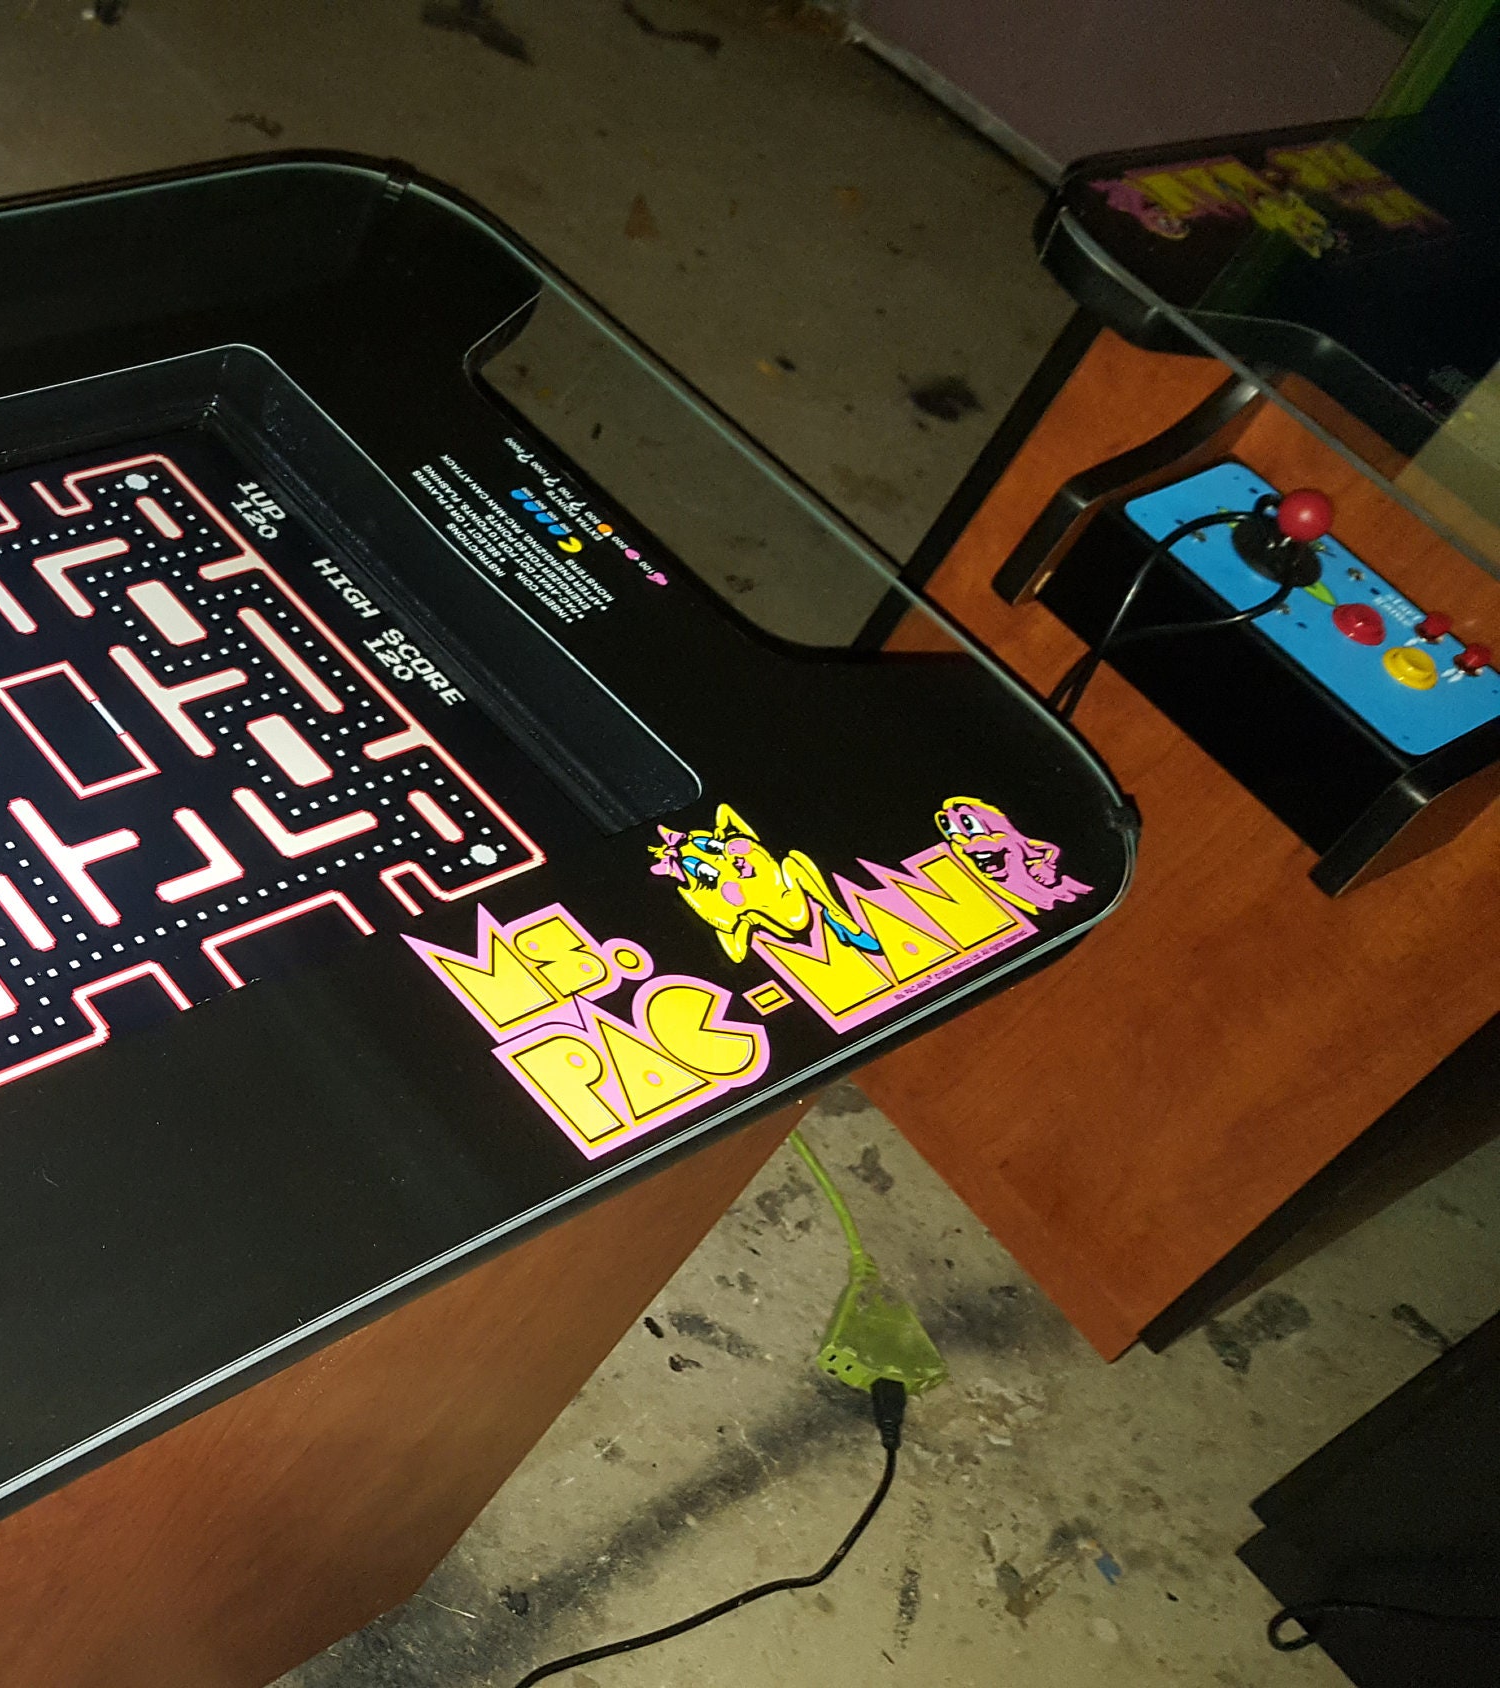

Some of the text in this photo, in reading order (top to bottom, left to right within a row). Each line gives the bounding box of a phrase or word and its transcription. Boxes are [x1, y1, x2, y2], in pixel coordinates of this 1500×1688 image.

[231, 498, 278, 540] 120
[237, 481, 286, 521] 1UP
[312, 558, 466, 706] HIGH SCORE
[363, 637, 414, 682] 120
